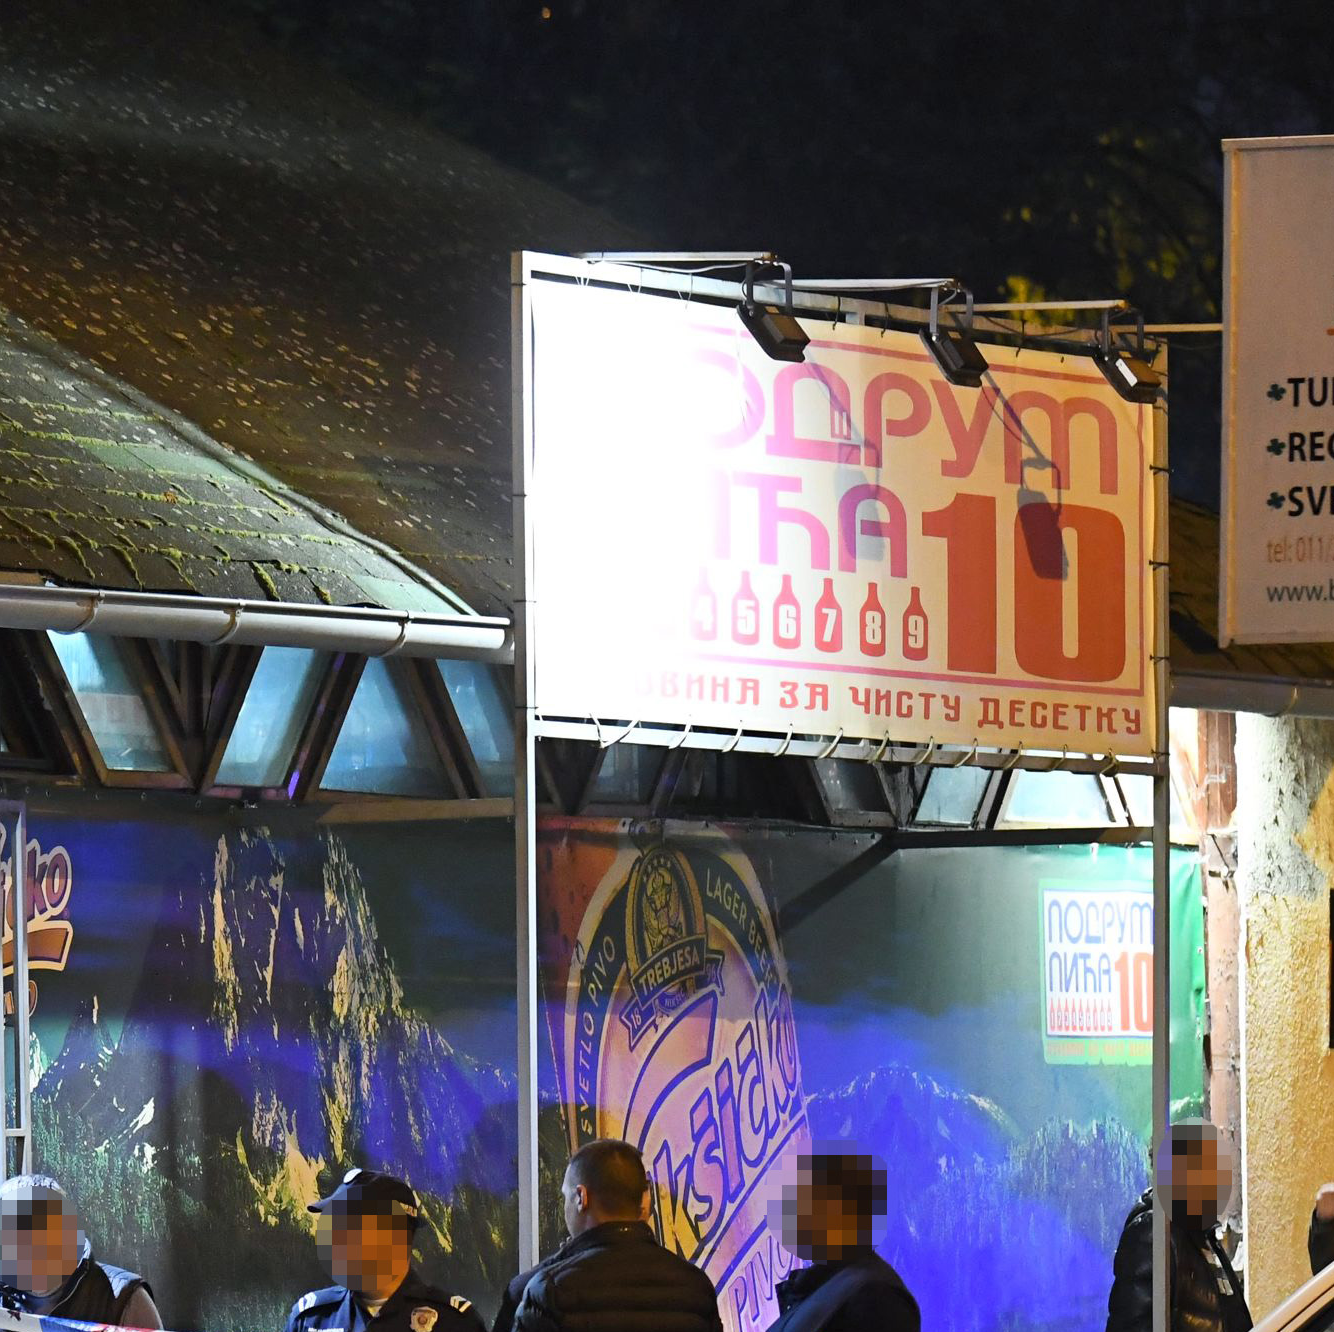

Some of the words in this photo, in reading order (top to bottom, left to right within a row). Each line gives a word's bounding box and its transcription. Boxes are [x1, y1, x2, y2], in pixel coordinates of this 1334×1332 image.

[921, 491, 1127, 684] 10
[738, 603, 756, 634] 5
[778, 604, 797, 639] 6
[820, 607, 837, 642] 7
[865, 609, 883, 646] 8
[908, 613, 925, 650] 9
[779, 681, 829, 711] ЗА
[849, 686, 962, 722] ЧИСТУ
[977, 697, 1142, 735] ДЕСЕТКУ
[706, 867, 748, 931] LAGER
[1048, 898, 1154, 945] ПОДРУМ
[639, 945, 701, 997] TREBJESA
[1049, 950, 1112, 993] ПИЋА
[1115, 950, 1154, 1032] 10
[578, 1012, 595, 1136] SVETLO
[588, 935, 616, 1008] PIVO
